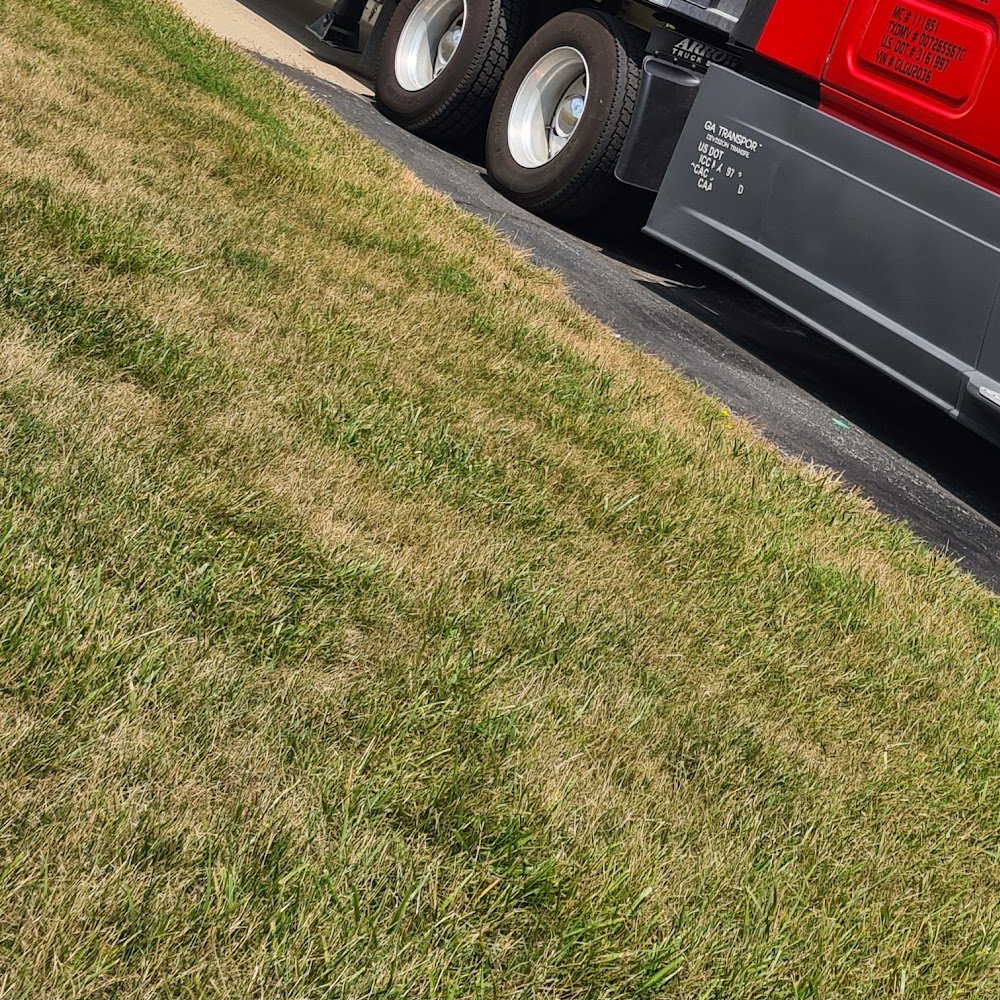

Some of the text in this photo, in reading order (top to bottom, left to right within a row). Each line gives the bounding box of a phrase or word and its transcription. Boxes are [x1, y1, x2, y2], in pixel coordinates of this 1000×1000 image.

[892, 6, 905, 20] MC
[674, 37, 742, 69] ARROW
[895, 38, 910, 55] DOT
[672, 47, 702, 64] TRUCK
[874, 51, 888, 65] VIN
[704, 120, 763, 152] GA TRANSPOR
[698, 141, 724, 161] US DOT
